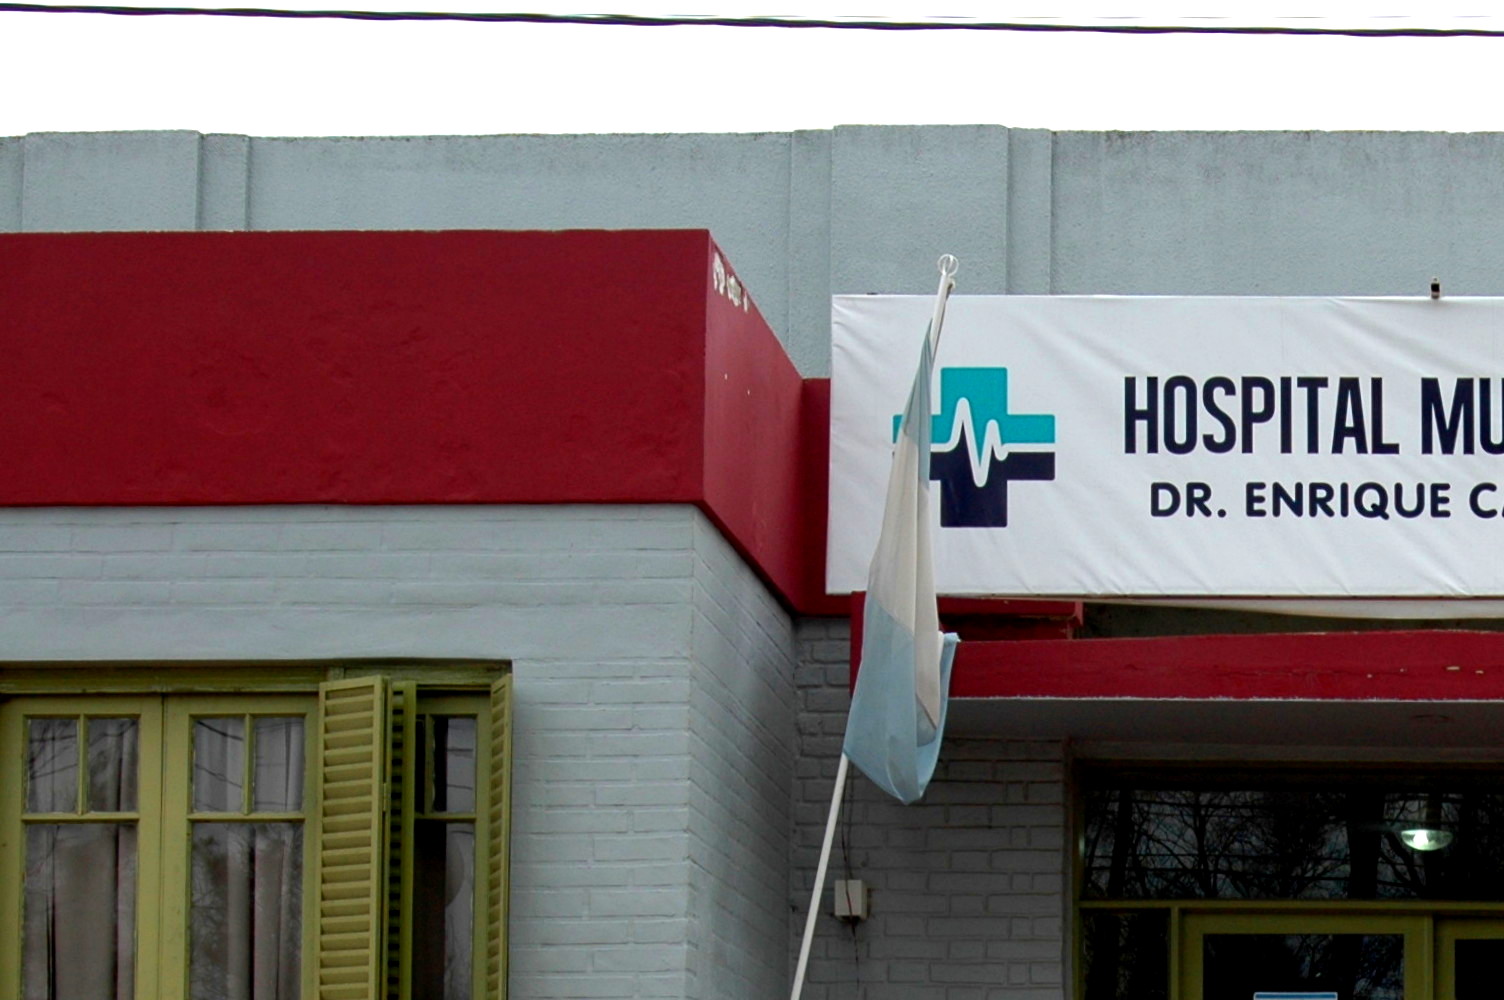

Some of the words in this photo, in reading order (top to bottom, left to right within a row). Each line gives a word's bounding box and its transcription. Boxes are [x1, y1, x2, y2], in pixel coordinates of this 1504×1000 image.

[1124, 376, 1400, 455] HOSPITAL
[1150, 482, 1227, 518] DR.
[1245, 481, 1451, 520] ENRIQUE
